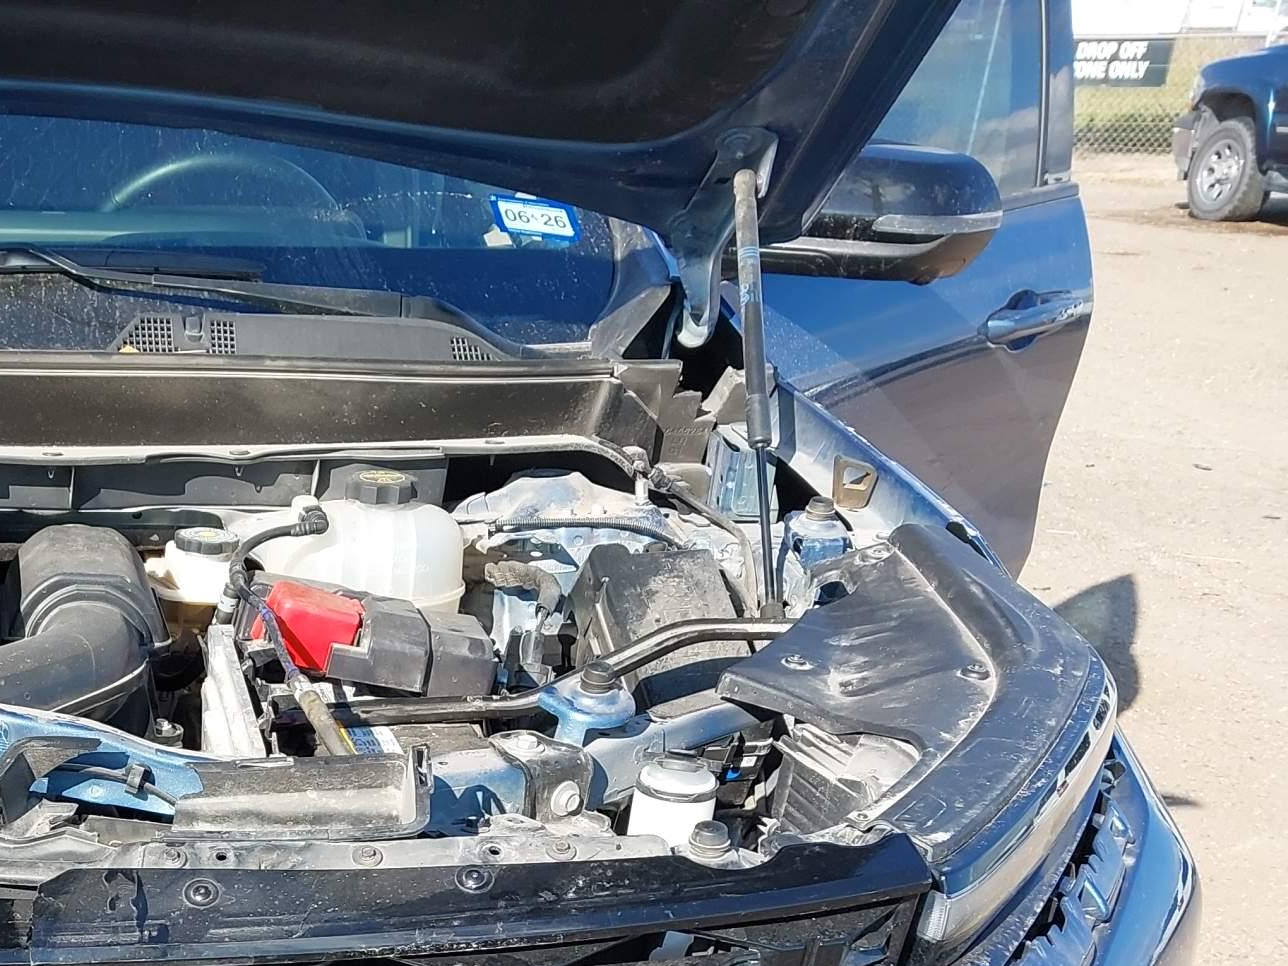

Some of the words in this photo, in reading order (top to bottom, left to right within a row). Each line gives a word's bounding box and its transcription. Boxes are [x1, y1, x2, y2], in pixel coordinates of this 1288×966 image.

[1076, 41, 1118, 60] DROP
[1119, 41, 1149, 60] OFF
[1073, 60, 1108, 80] ONE
[1108, 60, 1150, 80] ONLY
